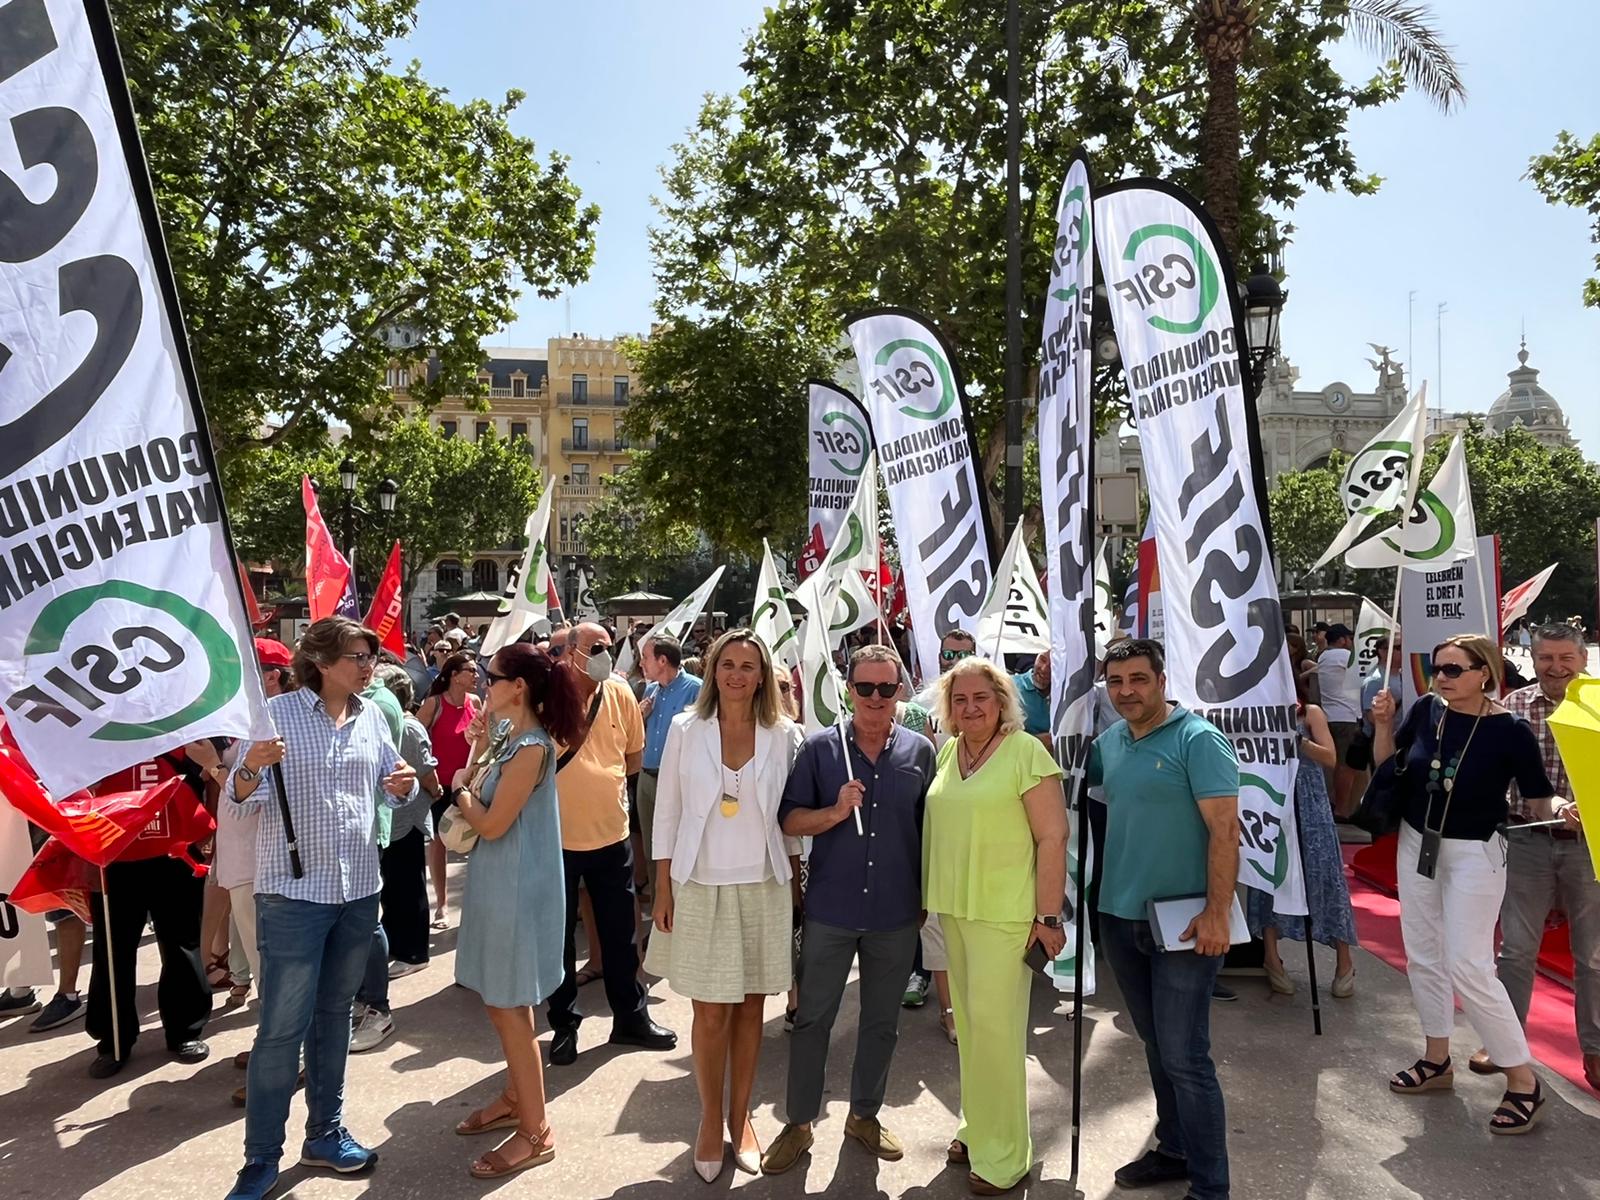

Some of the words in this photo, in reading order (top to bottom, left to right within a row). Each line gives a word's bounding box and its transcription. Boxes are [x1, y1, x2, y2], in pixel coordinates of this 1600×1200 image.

[1425, 566, 1464, 584] CELEBREM
[1426, 587, 1435, 601] EL
[1436, 585, 1456, 600] DRET
[1458, 584, 1464, 599] A
[1426, 603, 1440, 618] SER
